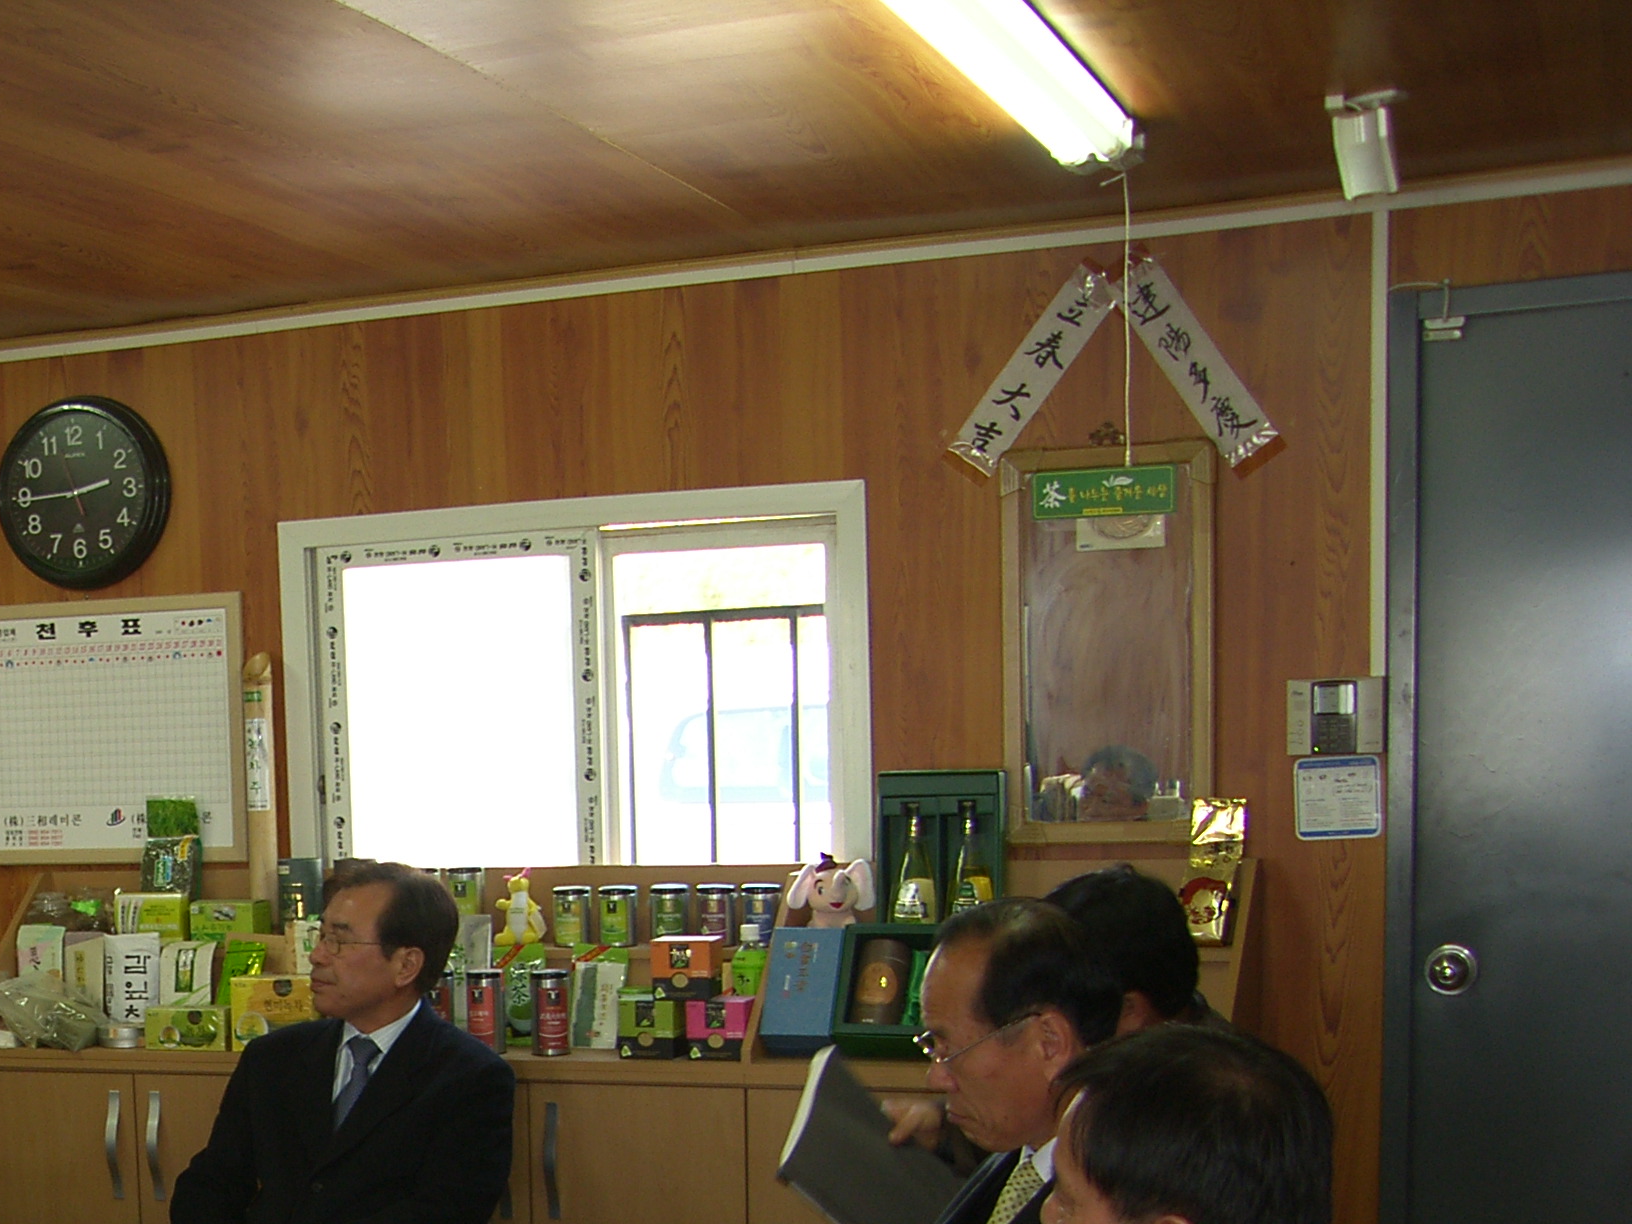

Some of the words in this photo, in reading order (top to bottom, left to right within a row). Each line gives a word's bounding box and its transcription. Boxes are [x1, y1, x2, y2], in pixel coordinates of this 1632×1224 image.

[975, 296, 1090, 453] 立春大吉
[64, 425, 83, 446] 12
[96, 430, 103, 450] 1
[41, 436, 57, 456] 11
[23, 458, 42, 479] 10
[113, 449, 127, 470] 2
[123, 477, 137, 497] 3
[18, 487, 31, 508] 9
[28, 514, 42, 534] 8
[116, 507, 130, 527] 4
[49, 534, 63, 554] 7
[73, 539, 87, 559] 6
[99, 529, 113, 549] 5
[36, 619, 142, 640] 천후표
